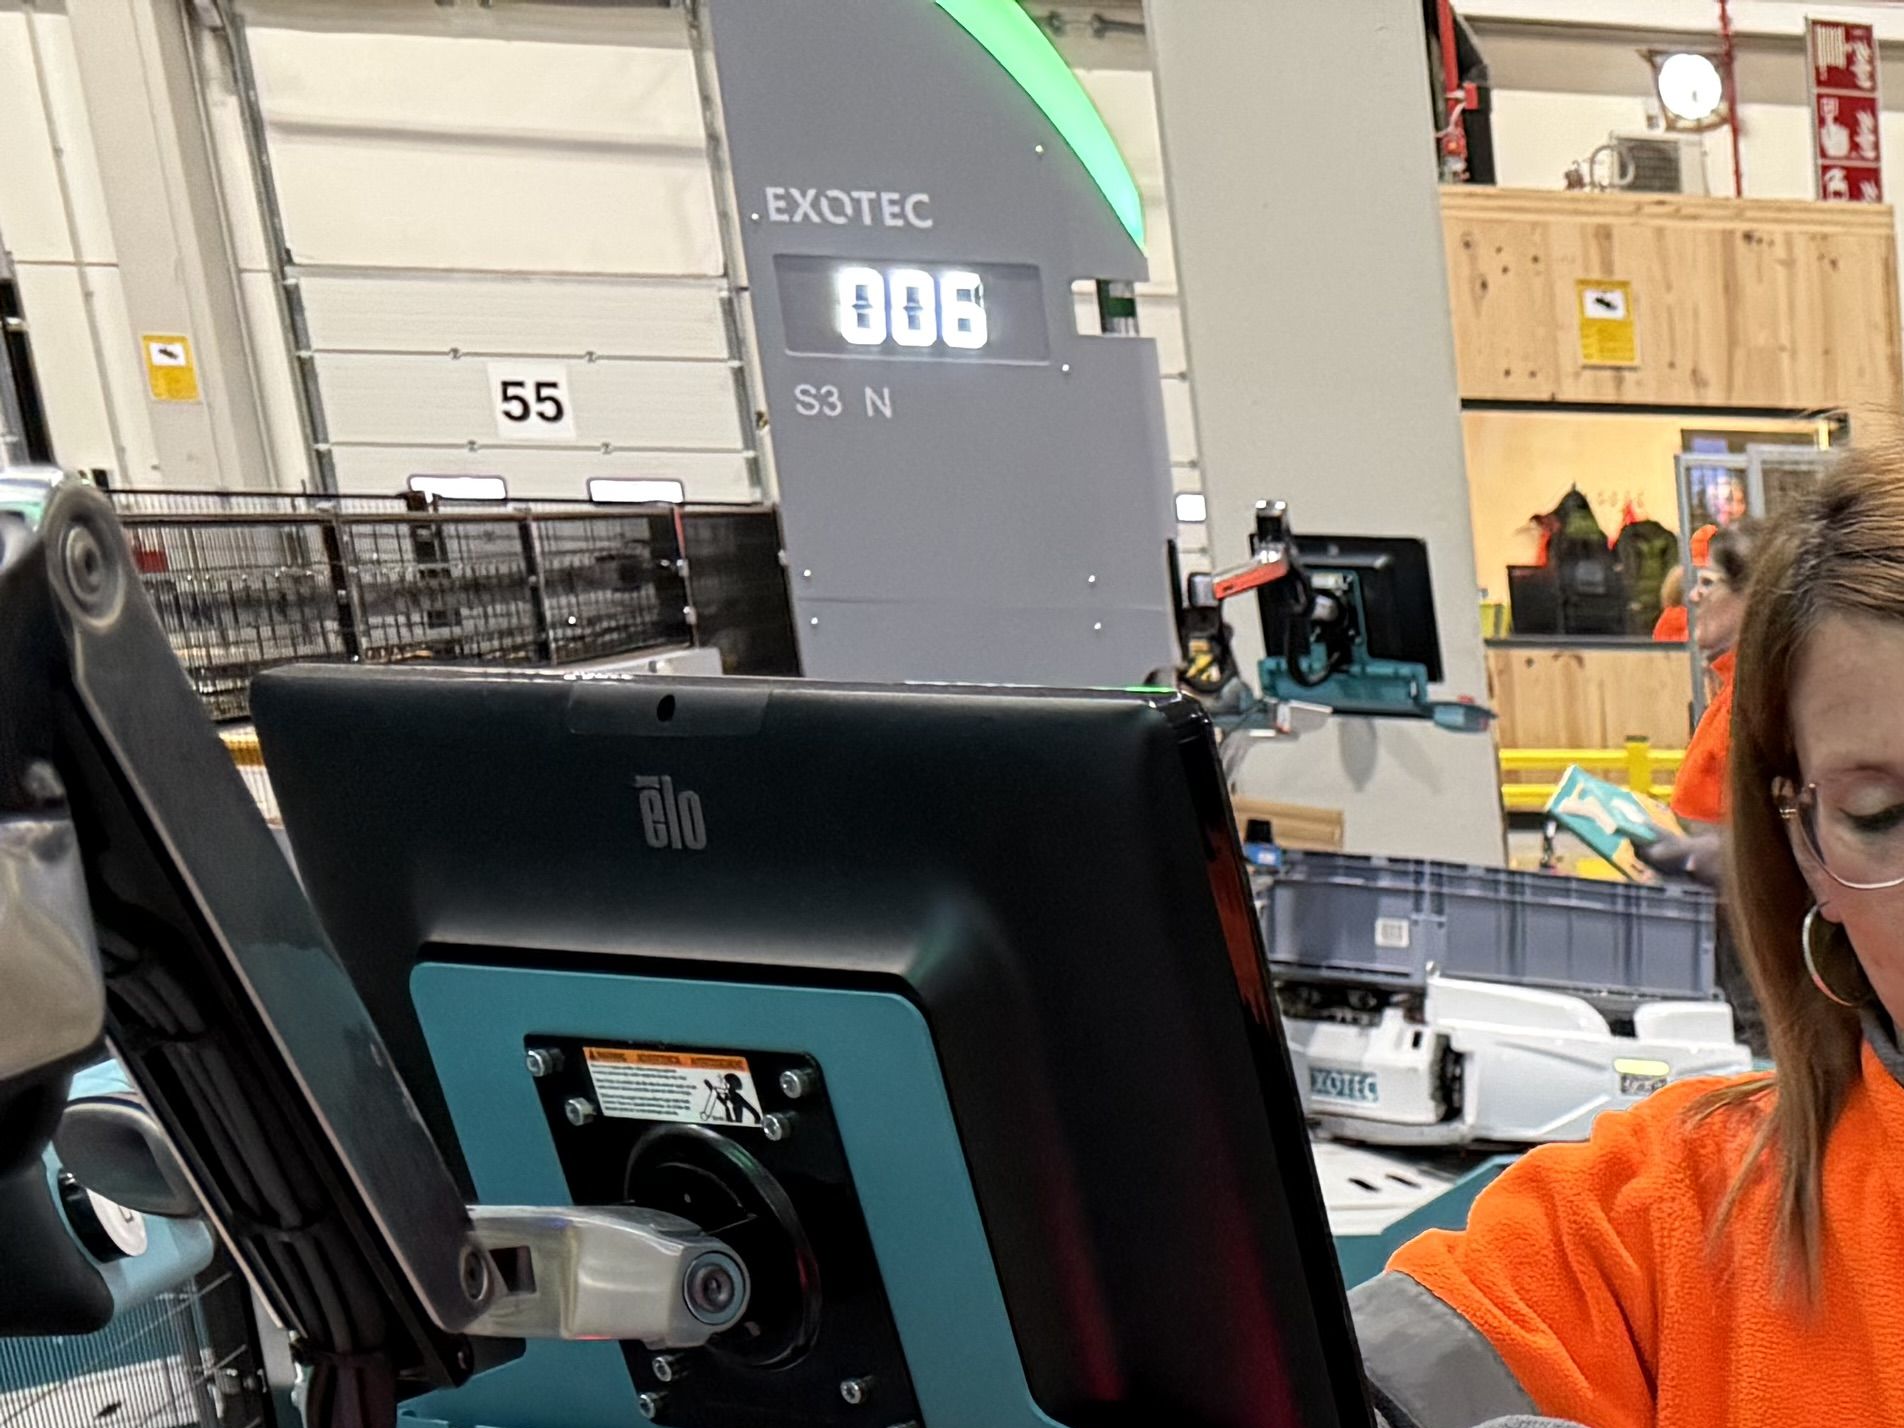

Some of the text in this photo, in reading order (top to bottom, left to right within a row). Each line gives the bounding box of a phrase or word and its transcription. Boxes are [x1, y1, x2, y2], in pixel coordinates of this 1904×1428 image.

[765, 186, 934, 229] EXOTEC
[838, 267, 988, 349] 006
[501, 380, 564, 422] 55
[794, 384, 892, 418] S3 N
